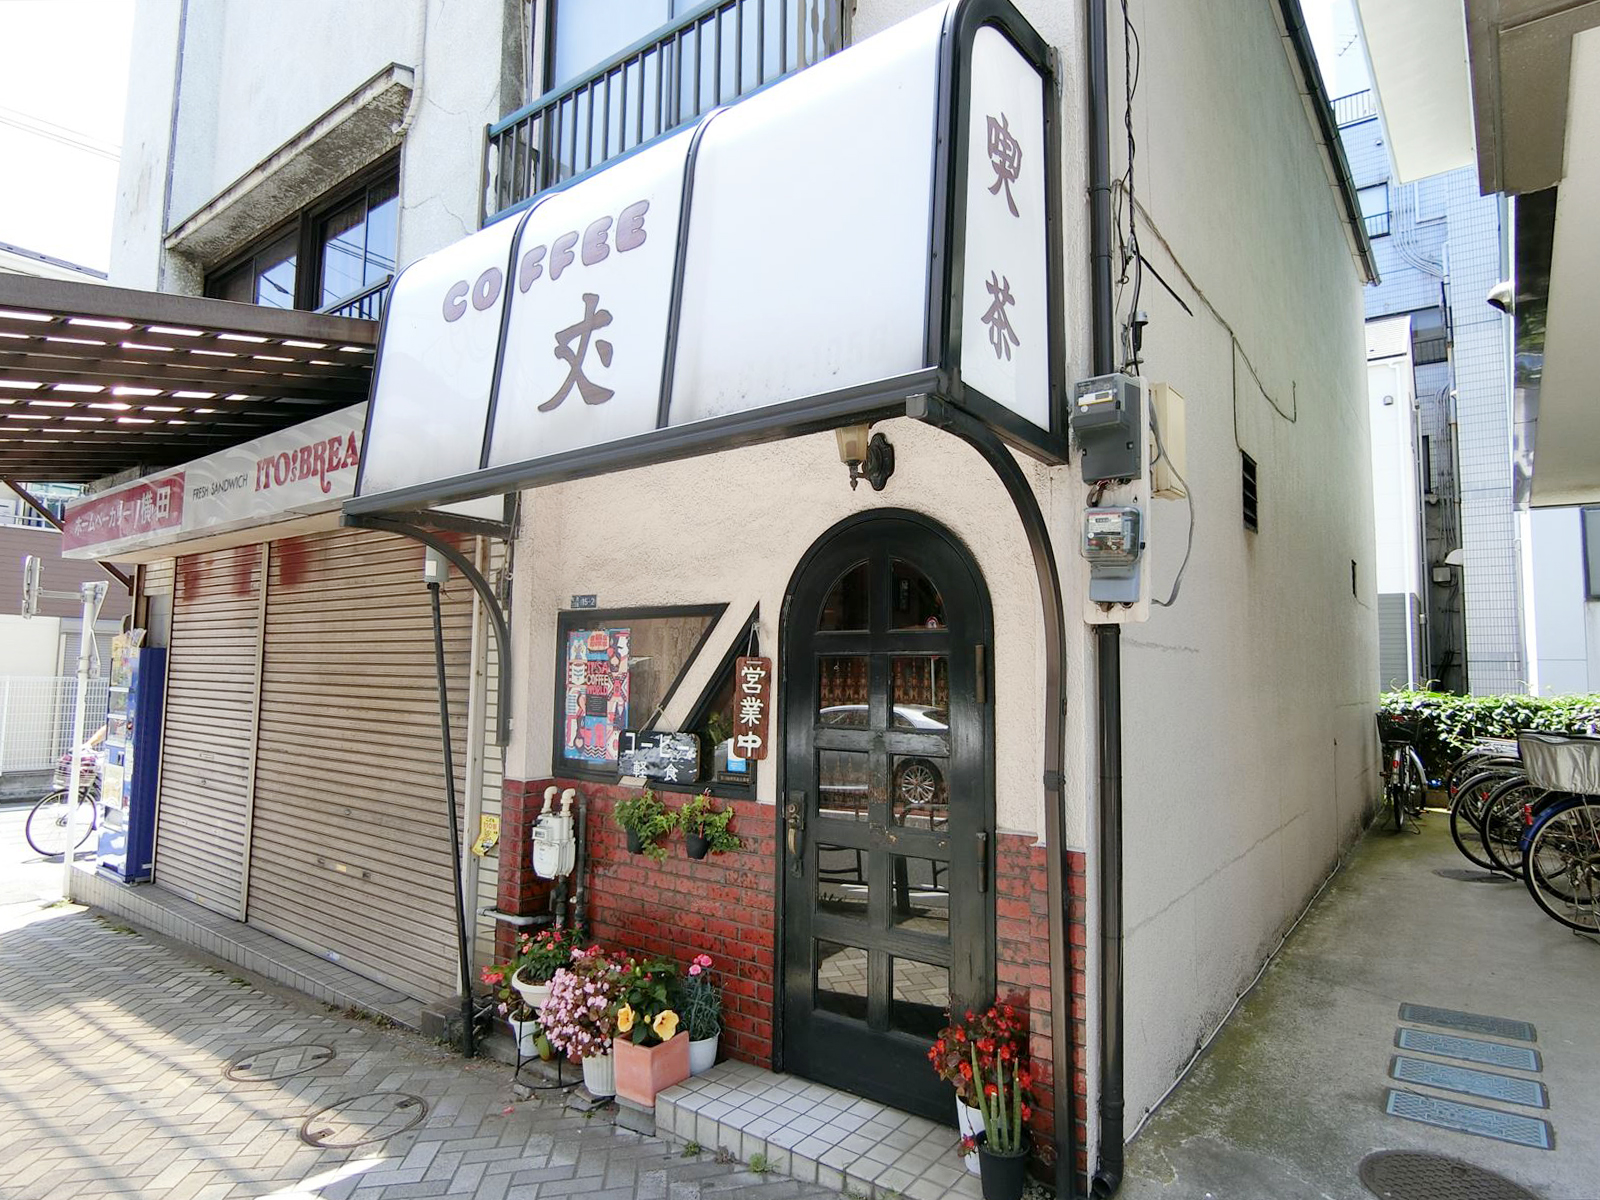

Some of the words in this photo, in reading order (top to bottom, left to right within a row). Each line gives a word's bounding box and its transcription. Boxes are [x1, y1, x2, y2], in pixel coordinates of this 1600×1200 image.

[442, 199, 650, 323] COFFEE
[192, 487, 210, 500] FRESH
[211, 473, 248, 496] SANDWICH
[586, 674, 609, 686] COFFEE
[737, 666, 766, 757] 営業中
[624, 732, 690, 758] コーヒー
[632, 760, 679, 782] 軽食
